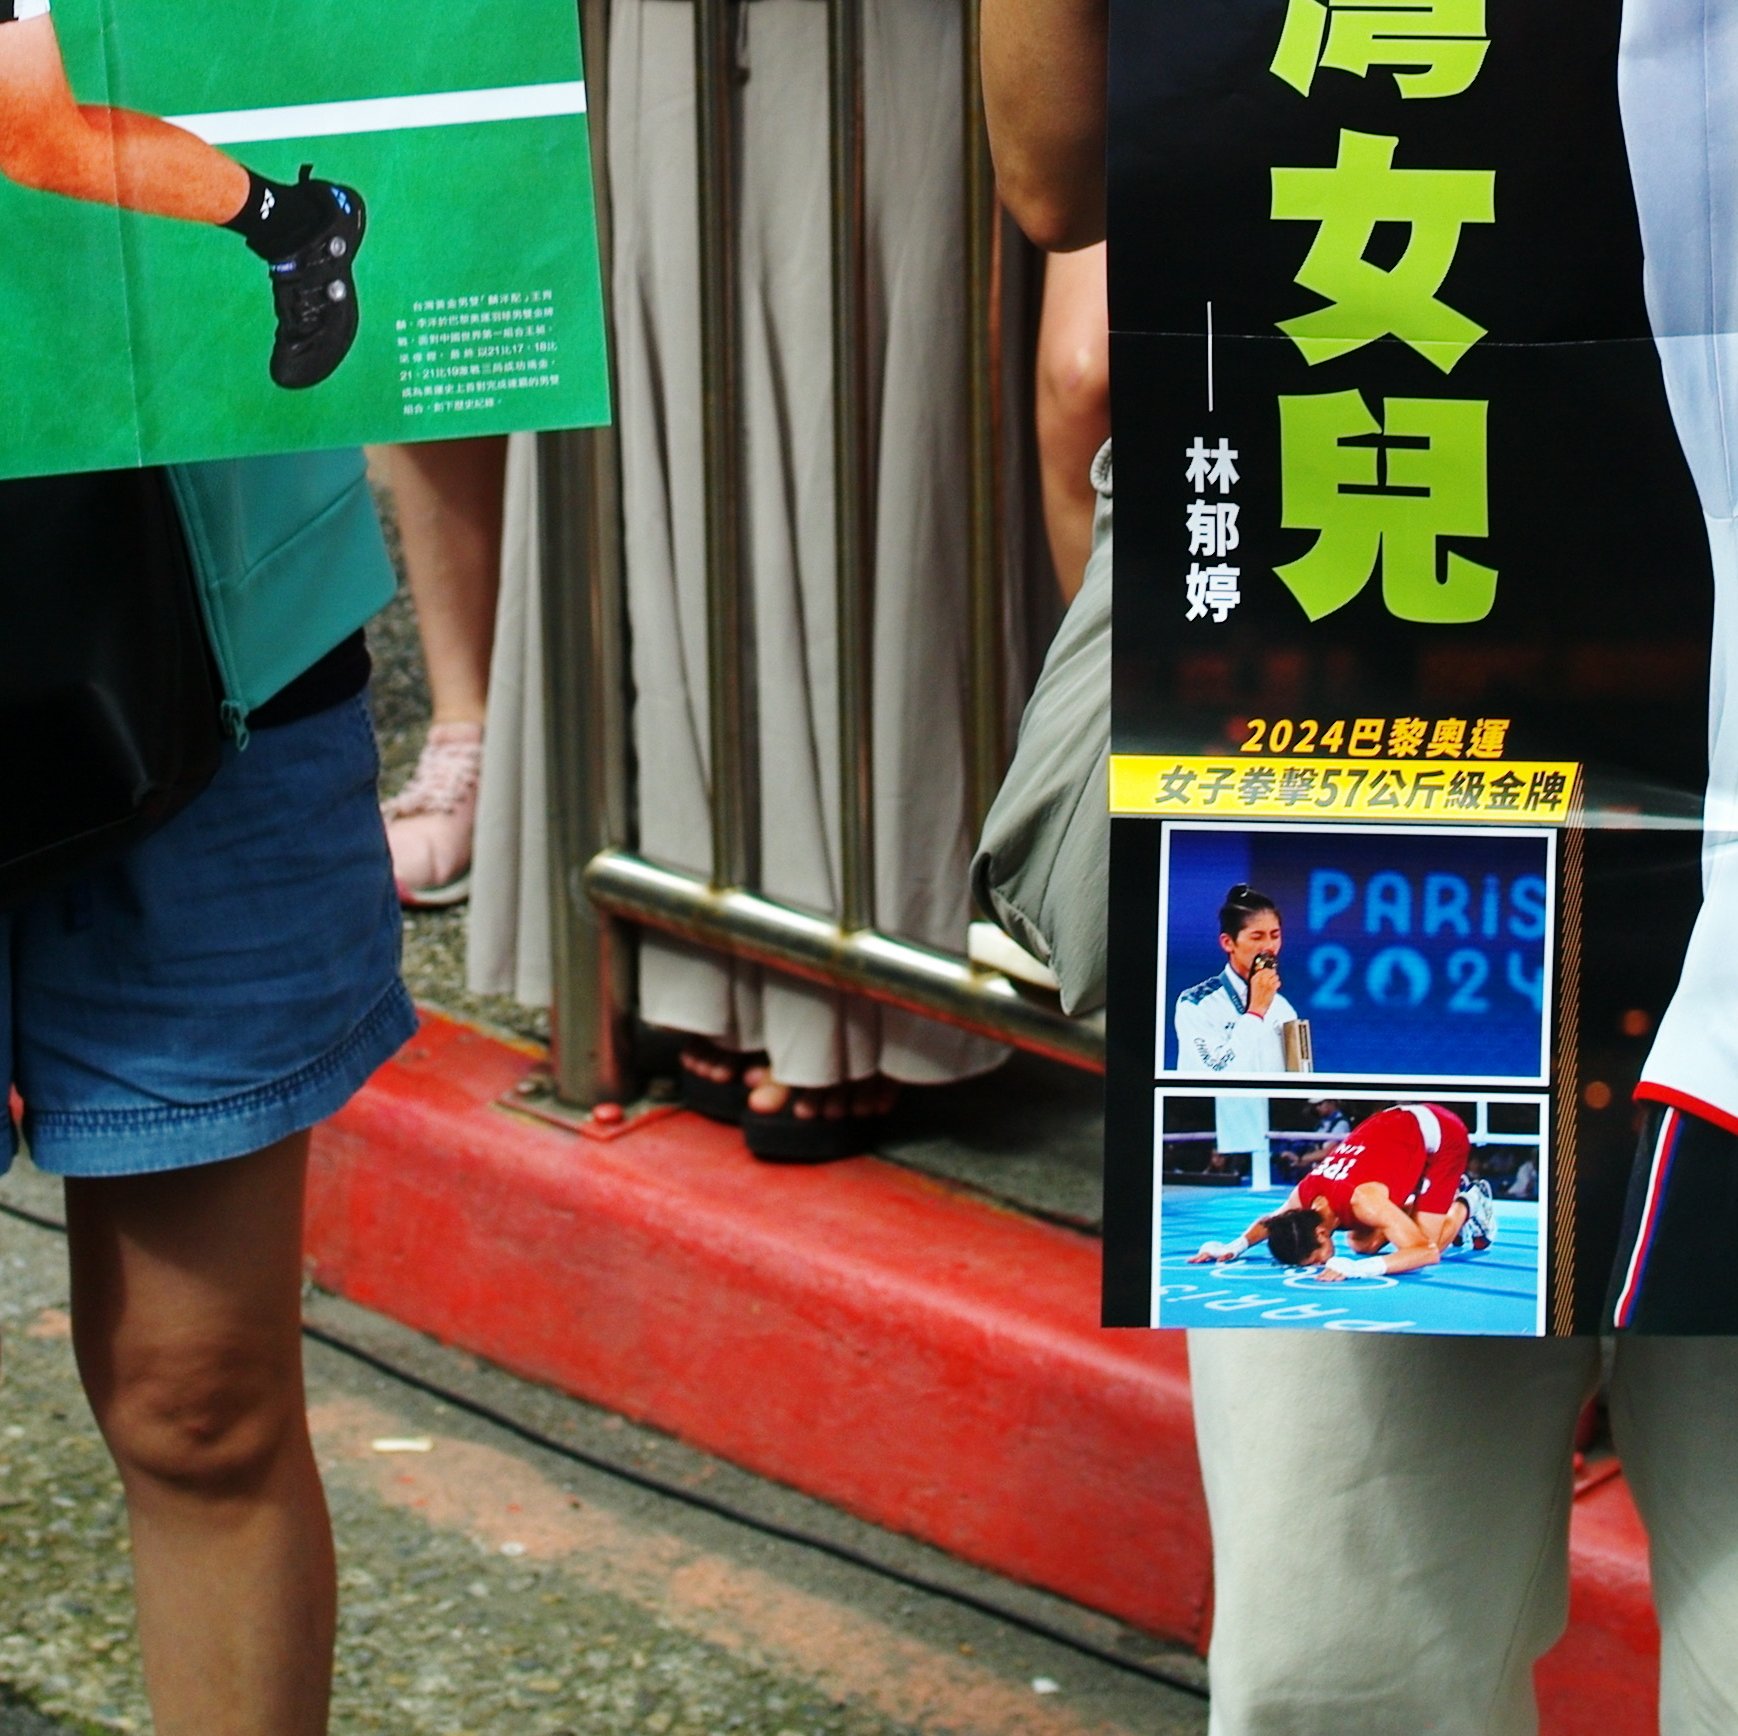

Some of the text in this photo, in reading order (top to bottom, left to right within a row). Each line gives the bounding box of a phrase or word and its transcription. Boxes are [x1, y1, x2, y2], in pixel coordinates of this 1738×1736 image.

[1184, 437, 1240, 623] 林郁婷
[1241, 717, 1511, 758] 2024巴黎奧運
[1155, 764, 1566, 813] 女子拳擊57公斤級金牌
[1308, 944, 1543, 1012] 2024
